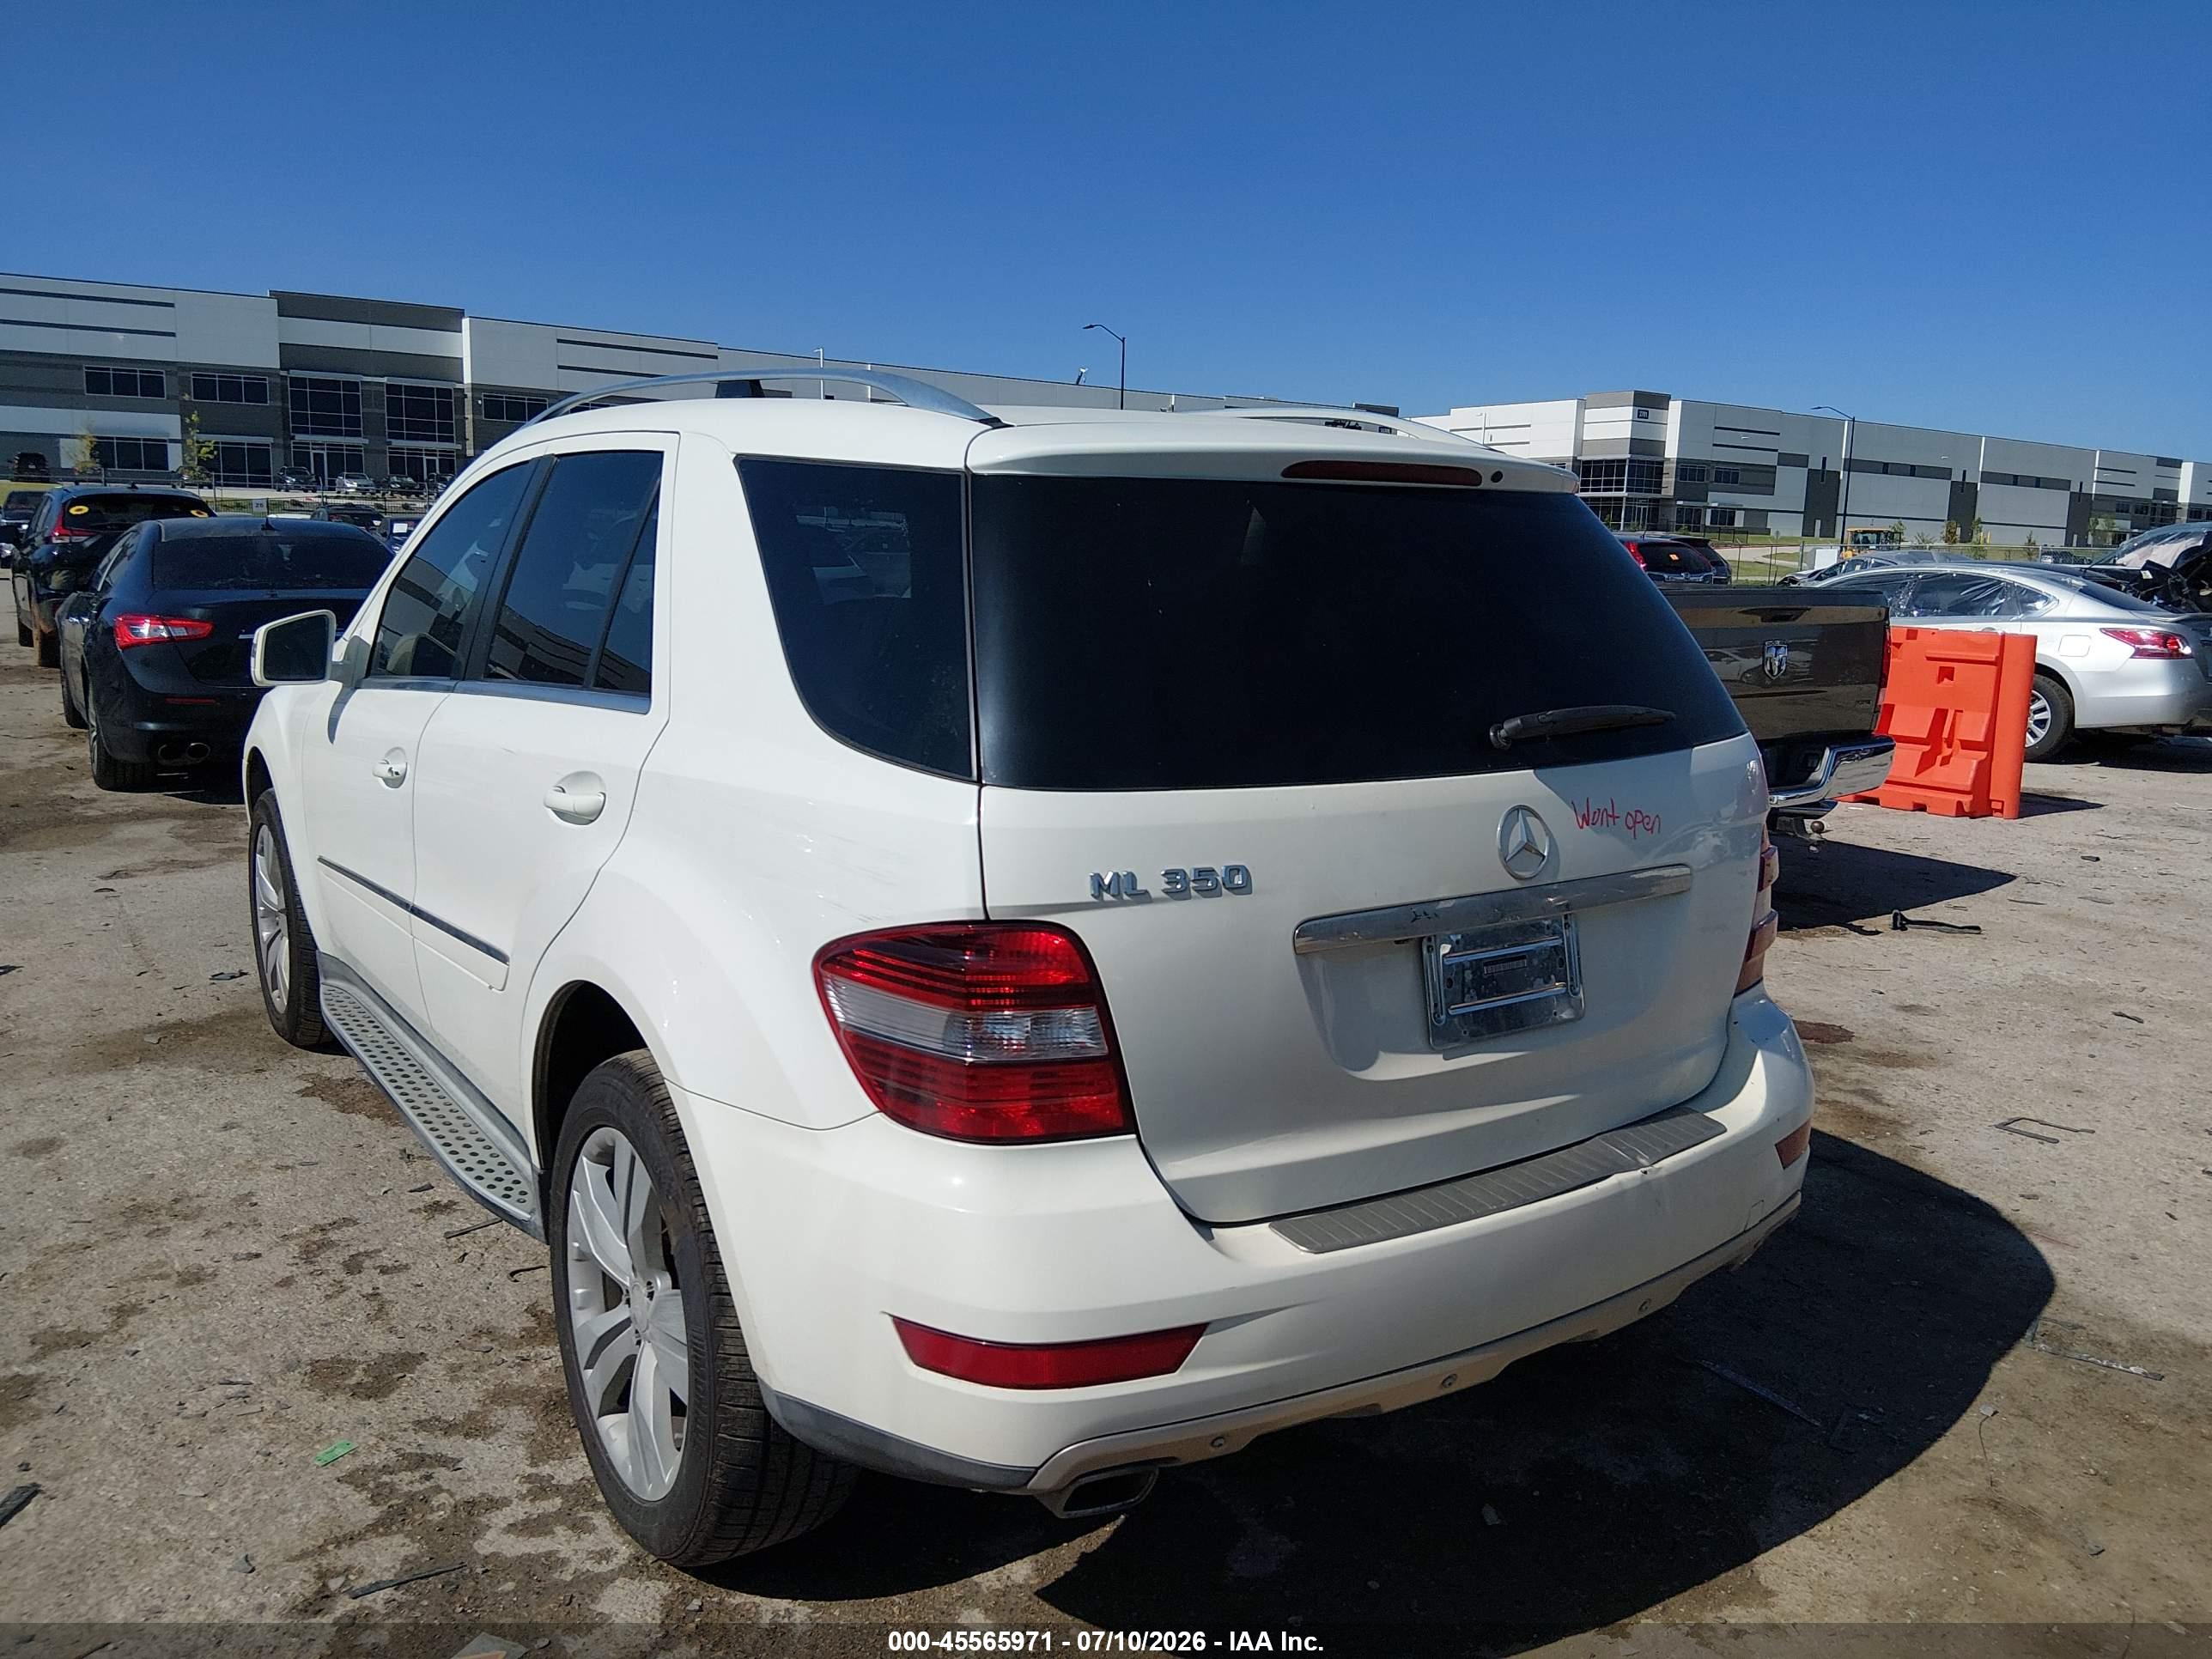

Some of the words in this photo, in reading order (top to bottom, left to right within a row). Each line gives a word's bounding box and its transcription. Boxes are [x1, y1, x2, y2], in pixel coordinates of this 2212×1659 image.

[1571, 797, 1620, 830] Wont
[1625, 810, 1662, 840] open
[1090, 871, 1149, 897] ML
[1160, 864, 1249, 896] 350
